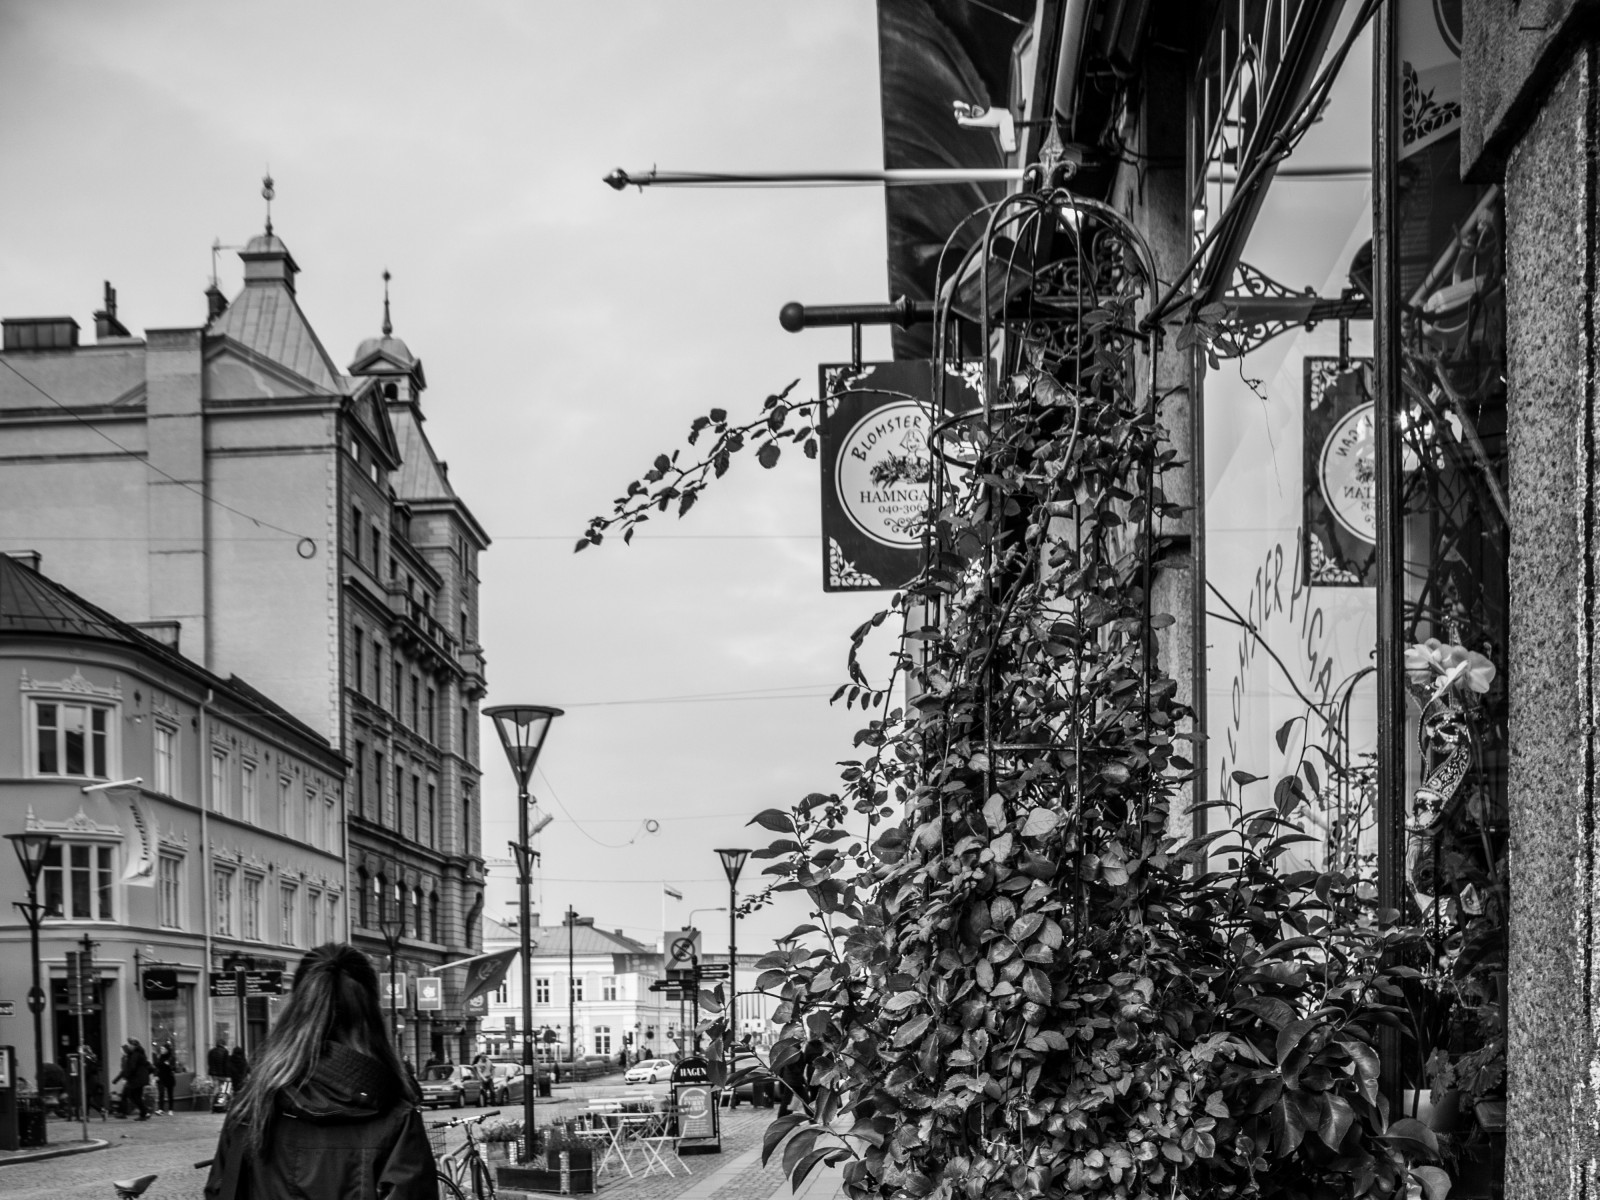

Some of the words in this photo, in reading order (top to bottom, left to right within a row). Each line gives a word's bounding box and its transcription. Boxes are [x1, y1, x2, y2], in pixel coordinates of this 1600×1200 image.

[851, 415, 922, 462] BLOMSTER
[1220, 543, 1283, 824] BLOMSTER
[680, 1067, 707, 1077] HAGEN
